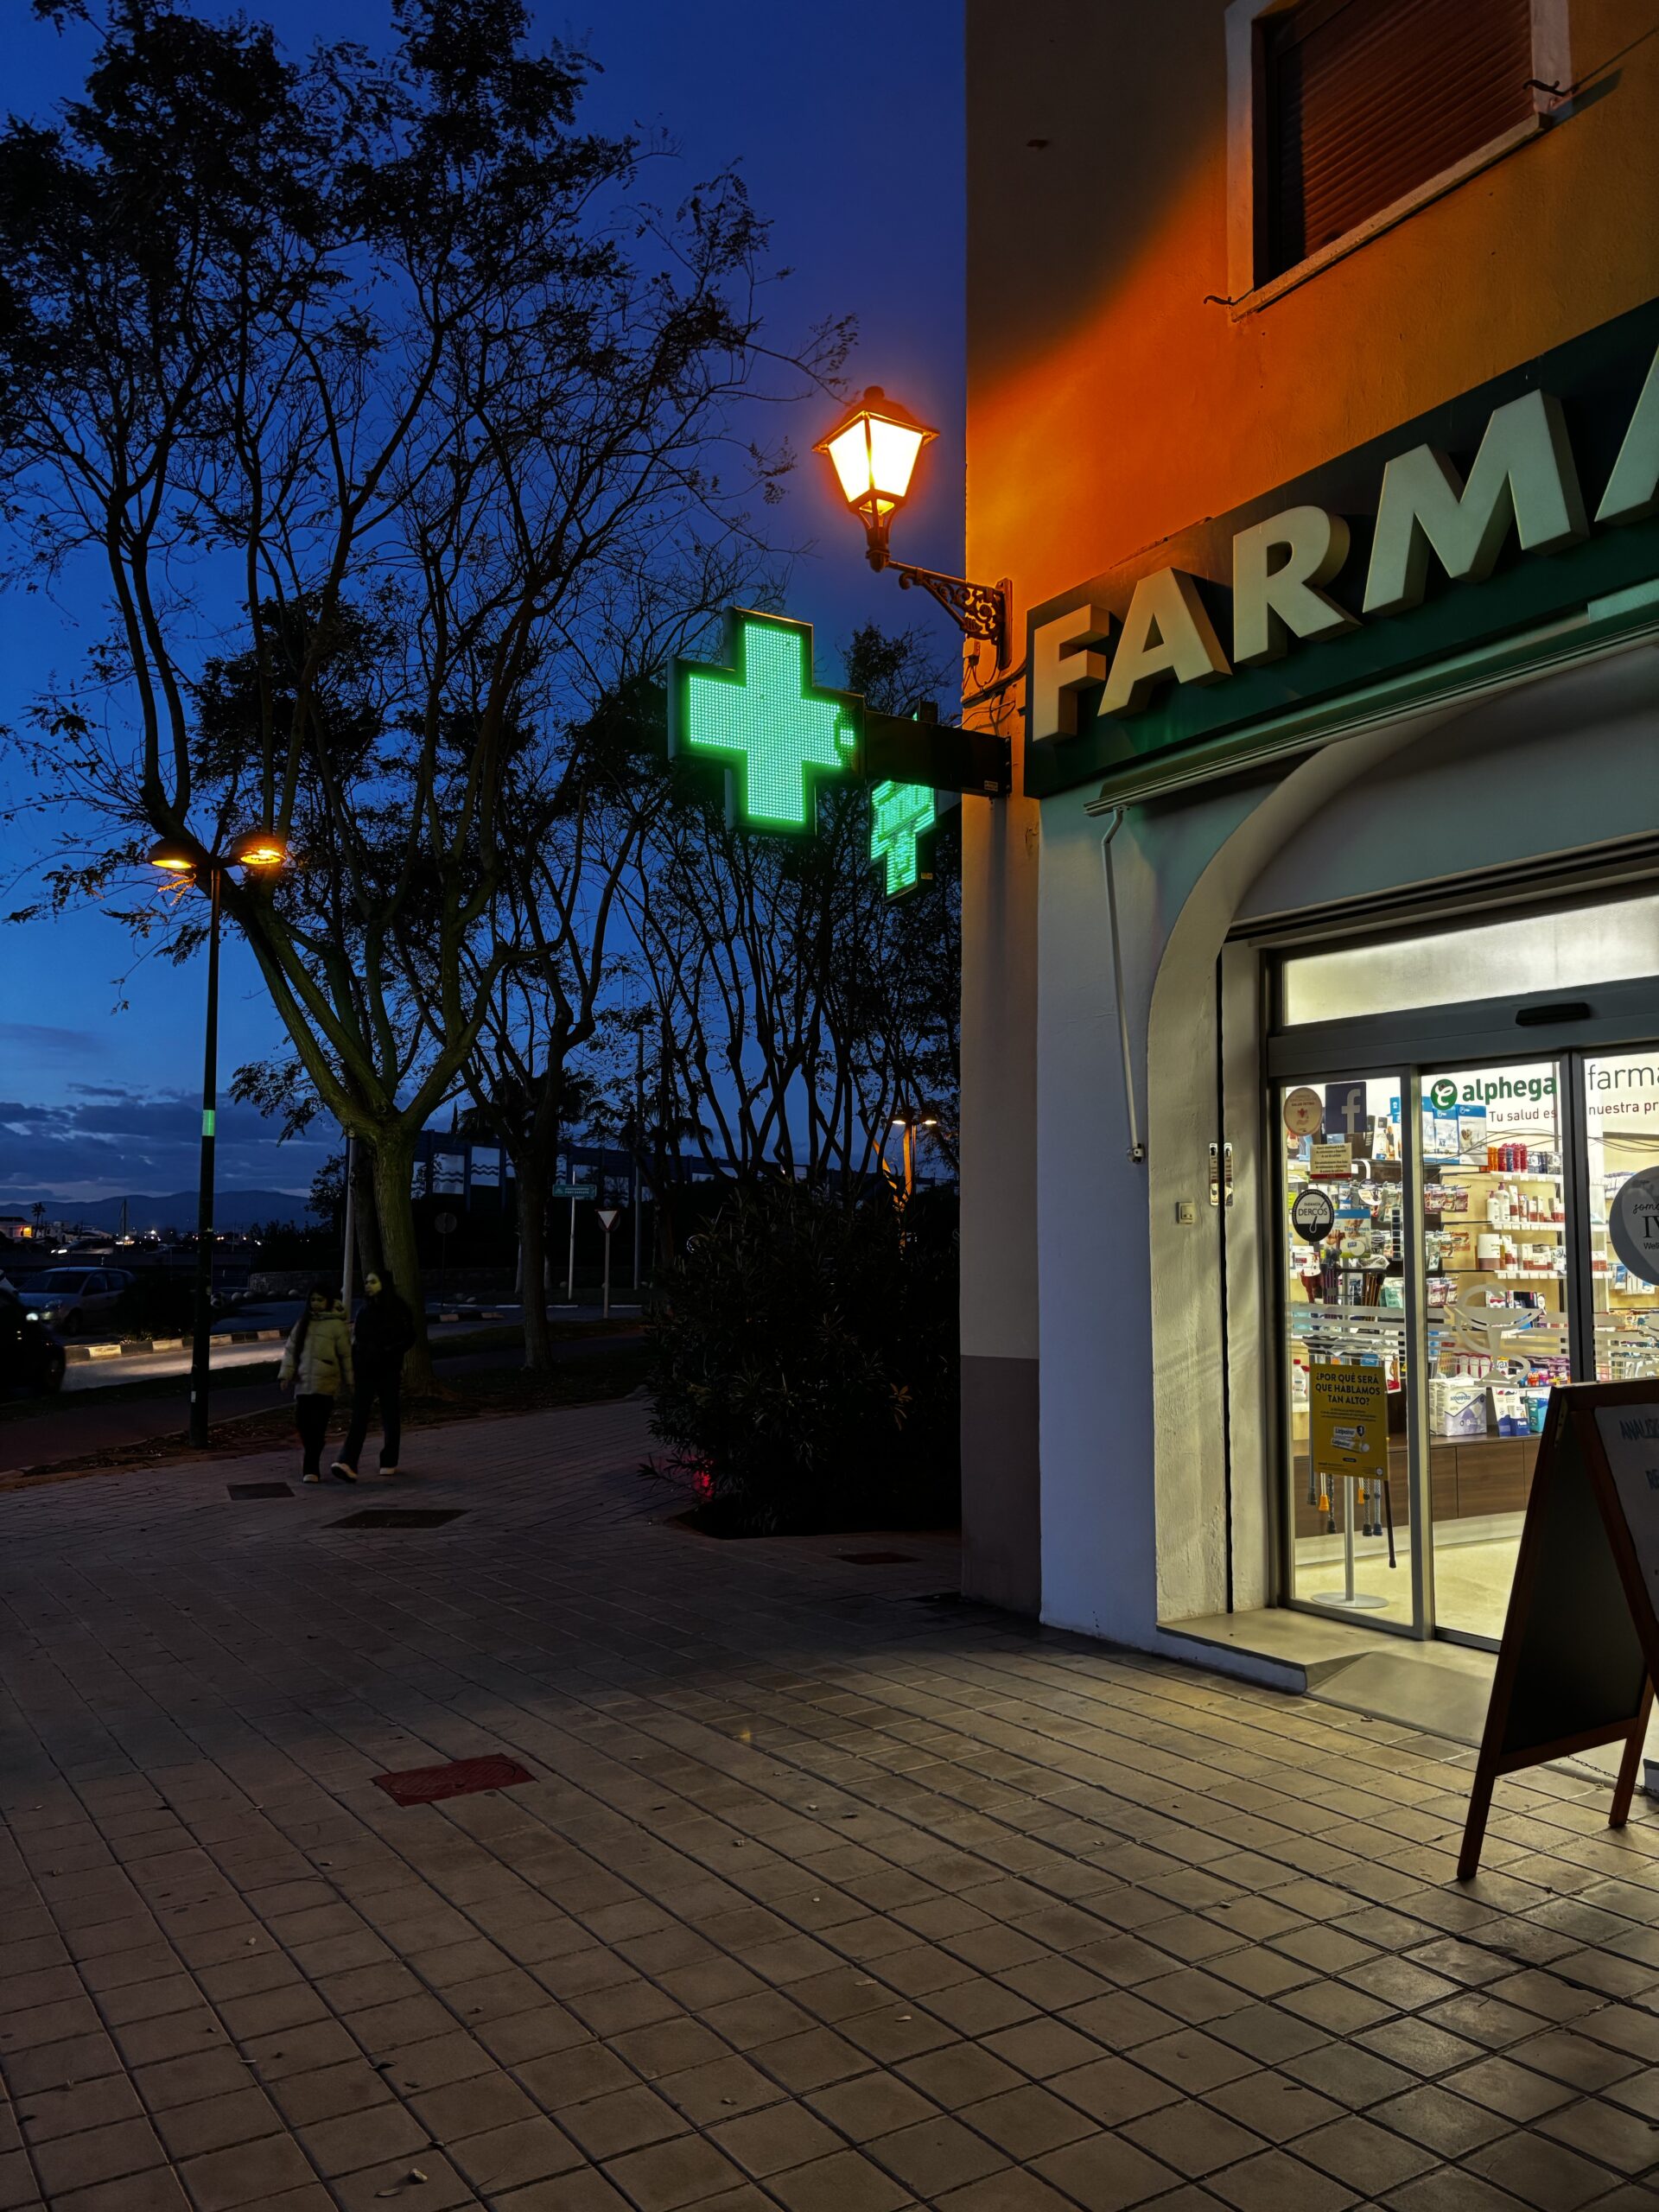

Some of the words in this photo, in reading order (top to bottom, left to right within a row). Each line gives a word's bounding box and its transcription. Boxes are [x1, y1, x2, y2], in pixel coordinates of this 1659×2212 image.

[1462, 1076, 1557, 1105] alphega
[1587, 1064, 1659, 1090] farm
[1489, 1111, 1503, 1122] Tu
[1507, 1108, 1540, 1121] salud
[1543, 1109, 1557, 1118] es
[1588, 1103, 1640, 1115] nuestra
[1298, 1207, 1328, 1217] DERCOS
[1316, 1373, 1336, 1382] ¿POR
[1338, 1372, 1356, 1383] QUÉ
[1357, 1374, 1379, 1384] SERÁ
[1315, 1383, 1332, 1393] QUE
[1334, 1384, 1381, 1395] HABLAMOS
[1328, 1395, 1344, 1403] TAN
[1345, 1395, 1370, 1405] ALTO?
